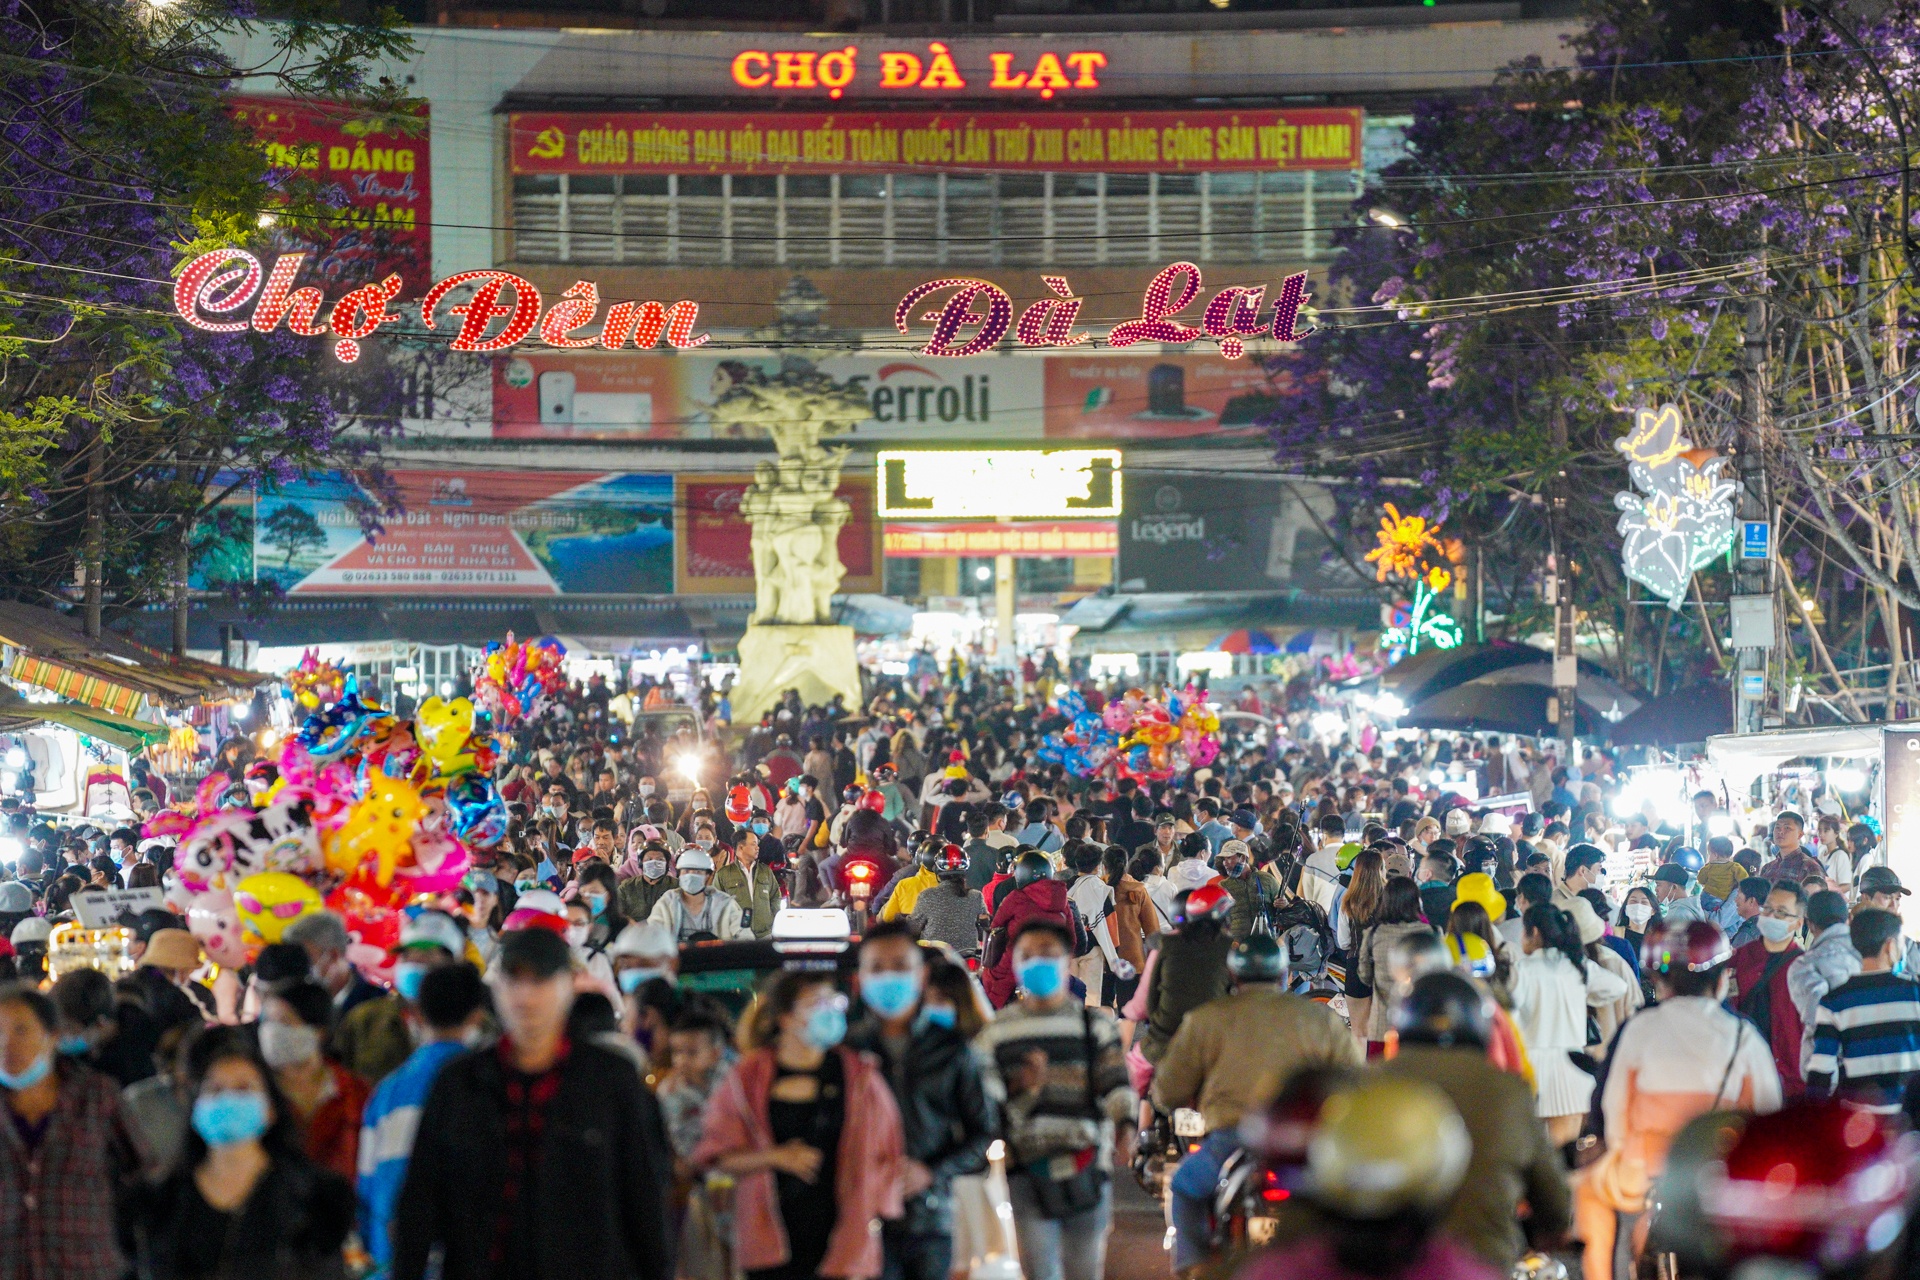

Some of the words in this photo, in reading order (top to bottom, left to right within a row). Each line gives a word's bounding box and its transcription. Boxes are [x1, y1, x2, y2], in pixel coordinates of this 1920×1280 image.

[731, 45, 857, 99] CHỢ
[879, 41, 966, 89] ĐÀ
[989, 52, 1108, 99] LẠT
[328, 140, 415, 172] ĐẢNG
[577, 121, 628, 164] CHÀO
[849, 121, 899, 163] TOÀN
[902, 115, 952, 165] QUỐC
[1067, 116, 1104, 162] CỦA
[1107, 116, 1158, 162] ĐẢNG
[1162, 120, 1213, 171] CỘNG
[1216, 114, 1256, 160] SẢN
[1258, 118, 1299, 168] VIỆT
[173, 248, 403, 364] Chợ
[420, 267, 711, 351] Đêm
[895, 275, 1090, 357] Đà
[1107, 261, 1319, 361] Lạt
[1131, 517, 1205, 544] Legend
[374, 543, 407, 553] MUA
[387, 555, 416, 565] CHO
